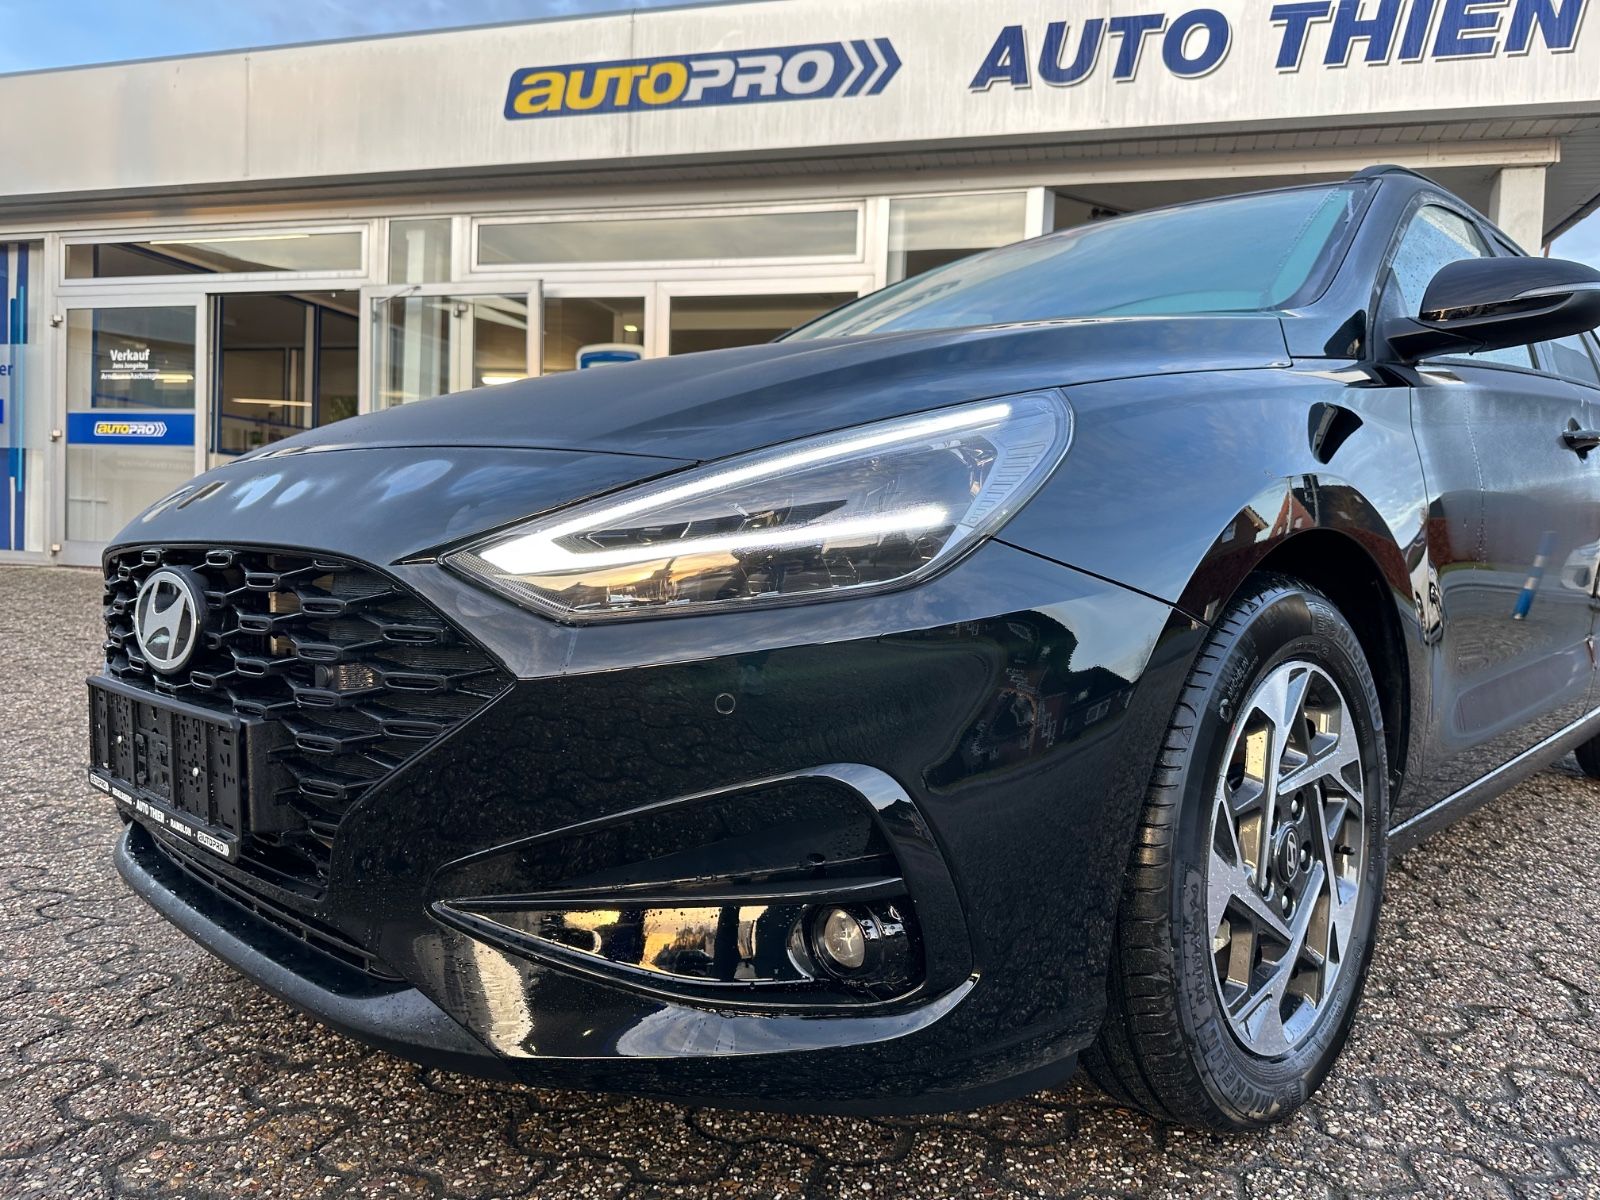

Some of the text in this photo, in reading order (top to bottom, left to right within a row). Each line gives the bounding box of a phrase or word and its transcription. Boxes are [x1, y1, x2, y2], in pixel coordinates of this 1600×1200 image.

[969, 0, 1587, 91] AUTO THIEN
[110, 349, 150, 361] Verkauf
[1337, 622, 1382, 729] MICHELIN
[136, 799, 149, 815] AUTO
